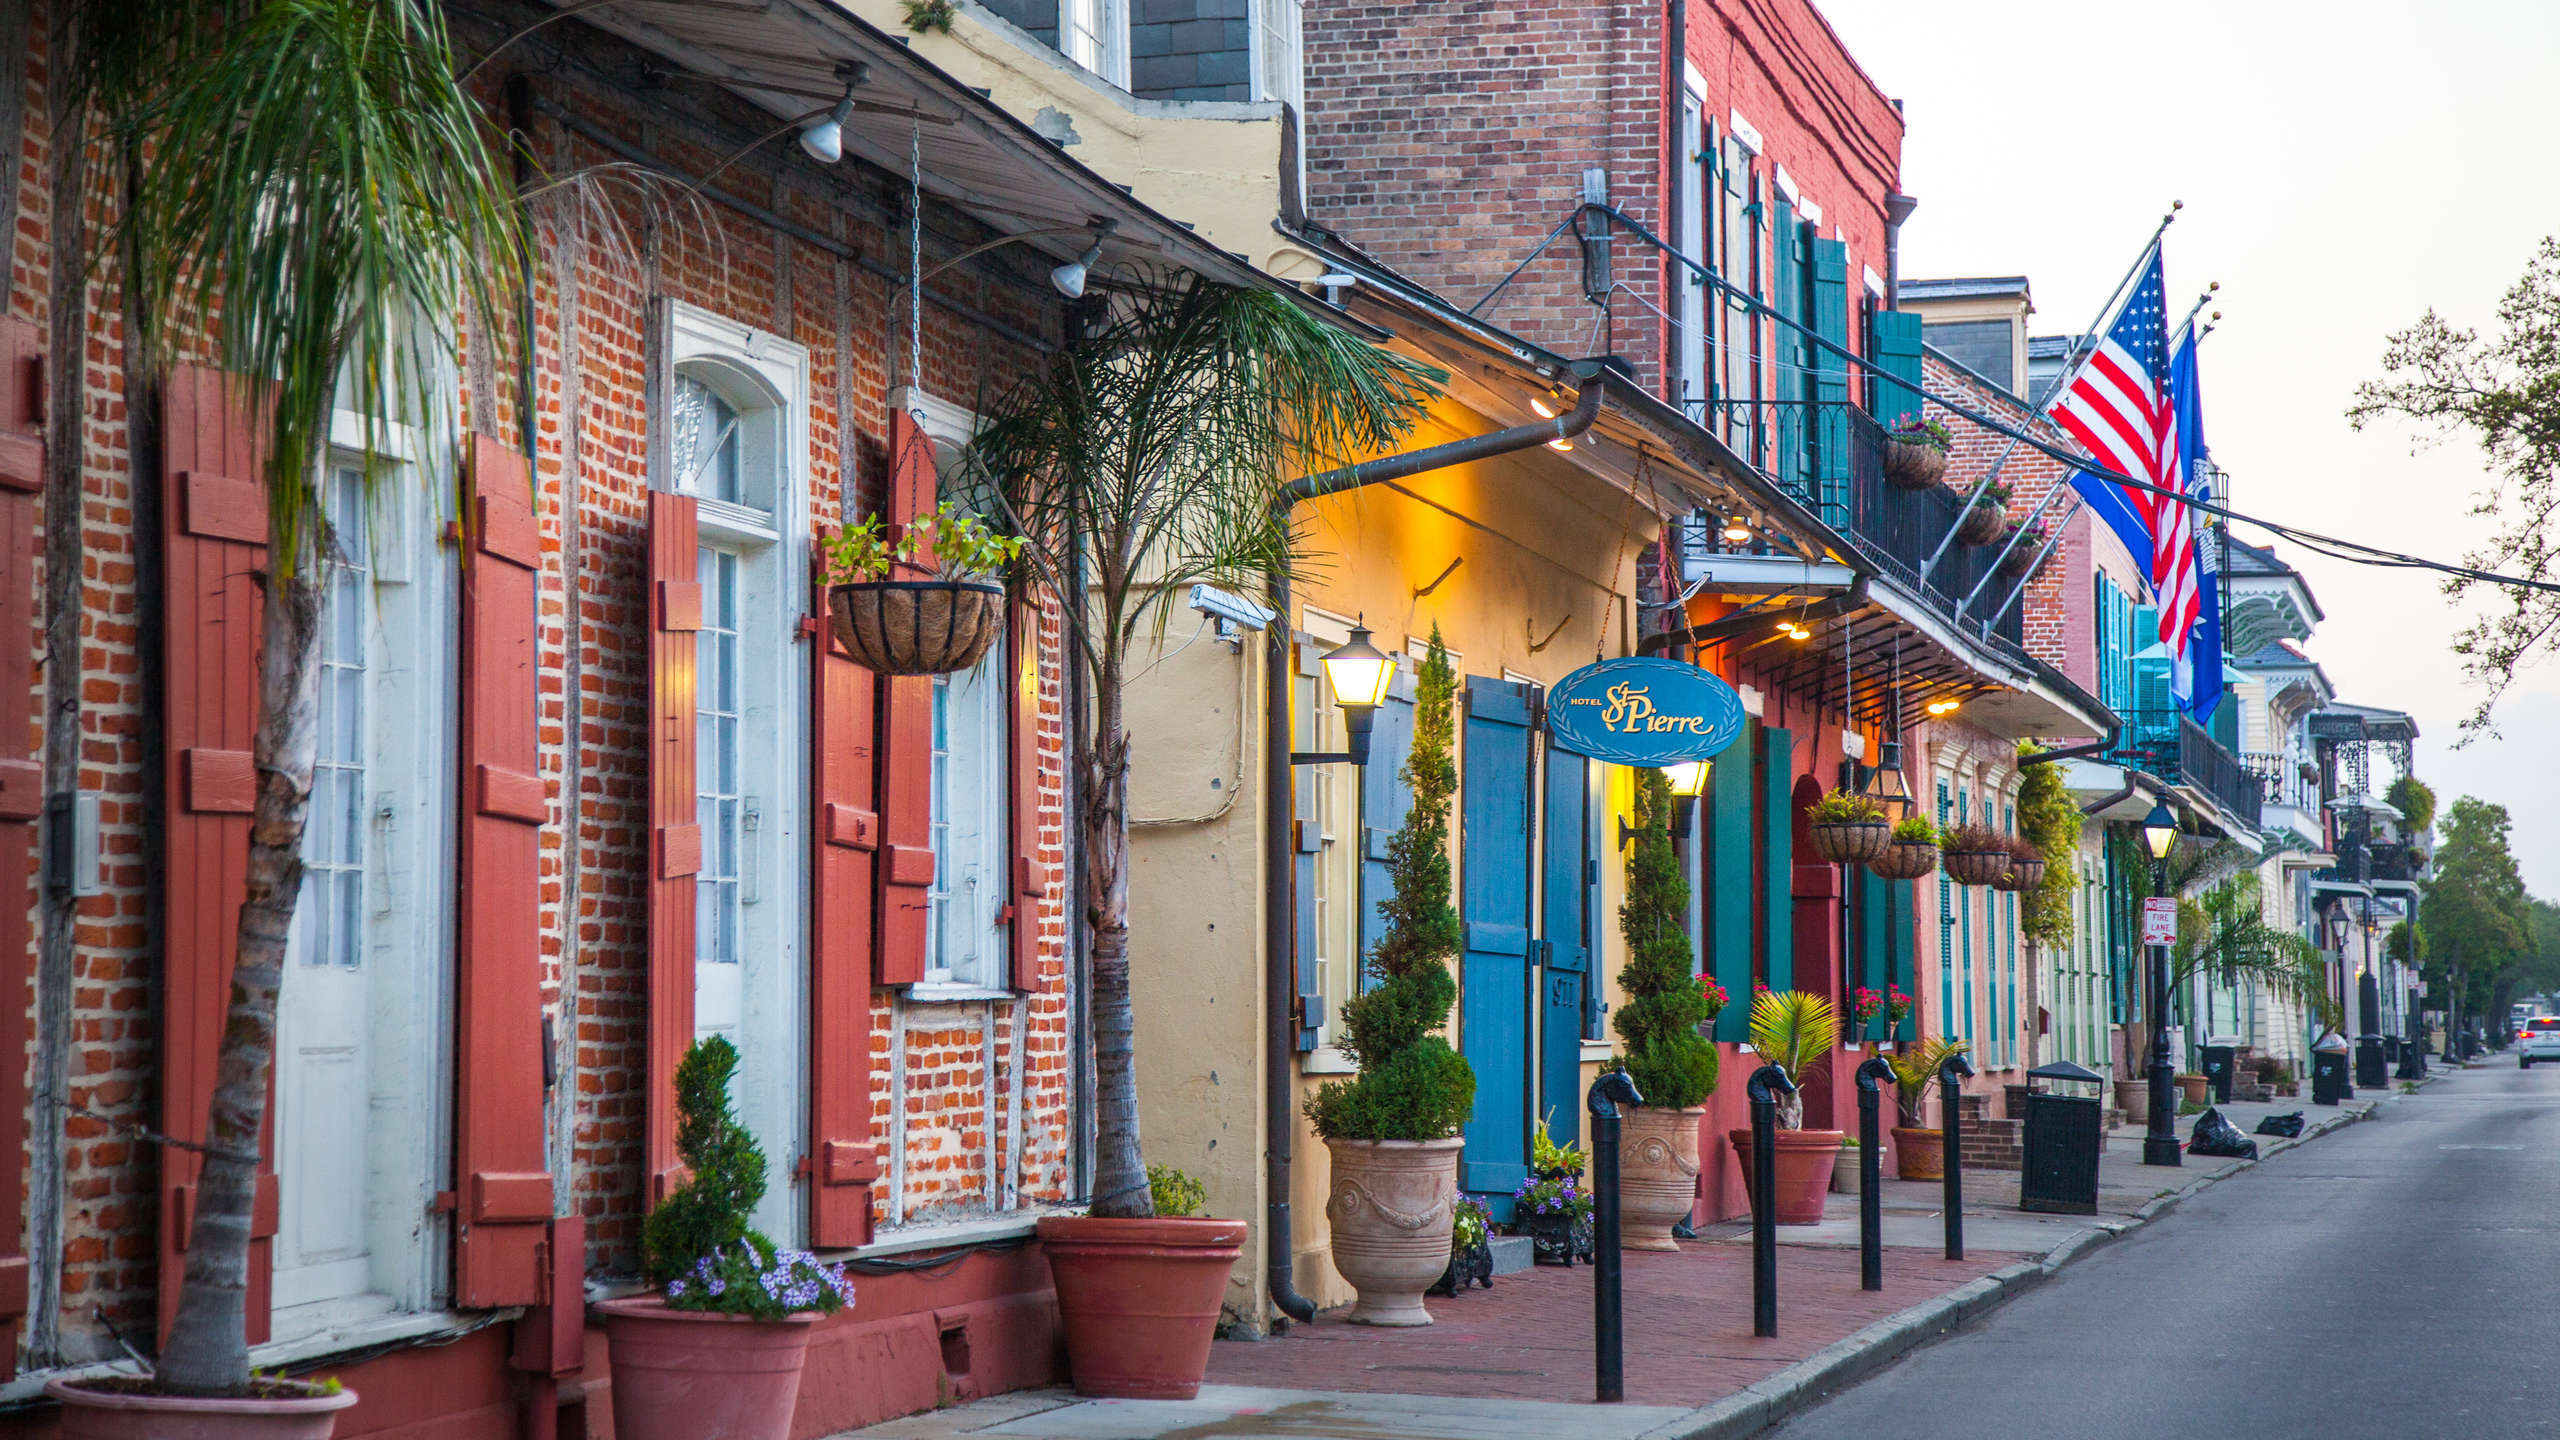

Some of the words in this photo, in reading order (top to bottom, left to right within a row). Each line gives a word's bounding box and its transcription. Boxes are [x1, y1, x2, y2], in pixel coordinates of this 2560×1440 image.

[1570, 698, 1603, 706] HOTEL
[1601, 680, 1649, 732] St
[1622, 695, 1715, 735] Pierre
[2151, 923, 2170, 932] LANE
[2152, 913, 2169, 922] FIRE
[1552, 976, 1575, 1008] 911
